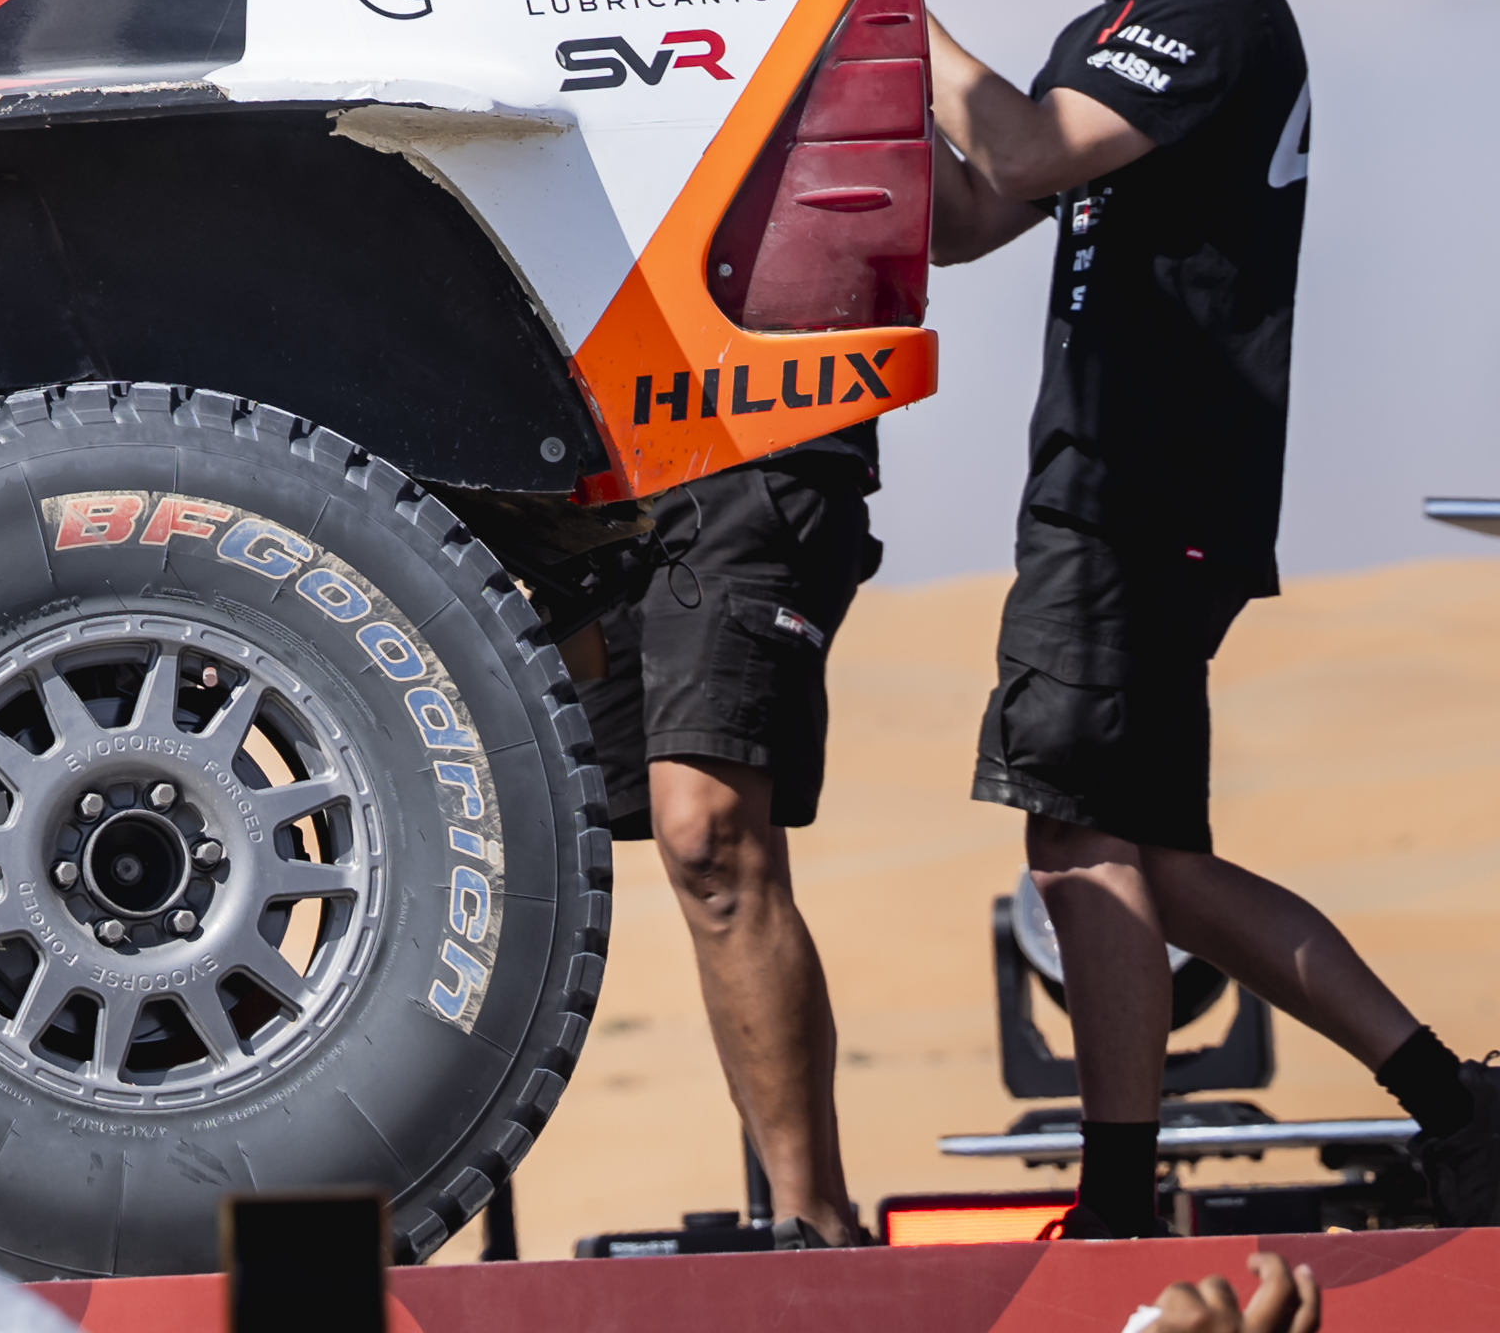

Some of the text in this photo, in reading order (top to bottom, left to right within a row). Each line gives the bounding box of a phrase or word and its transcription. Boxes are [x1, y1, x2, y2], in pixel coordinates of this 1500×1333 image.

[555, 27, 735, 93] SVR
[634, 347, 895, 426] HILUX
[64, 735, 264, 844] EVOCORSE FORGED
[18, 882, 80, 967] FORGED
[90, 953, 219, 992] EVOCORSE
